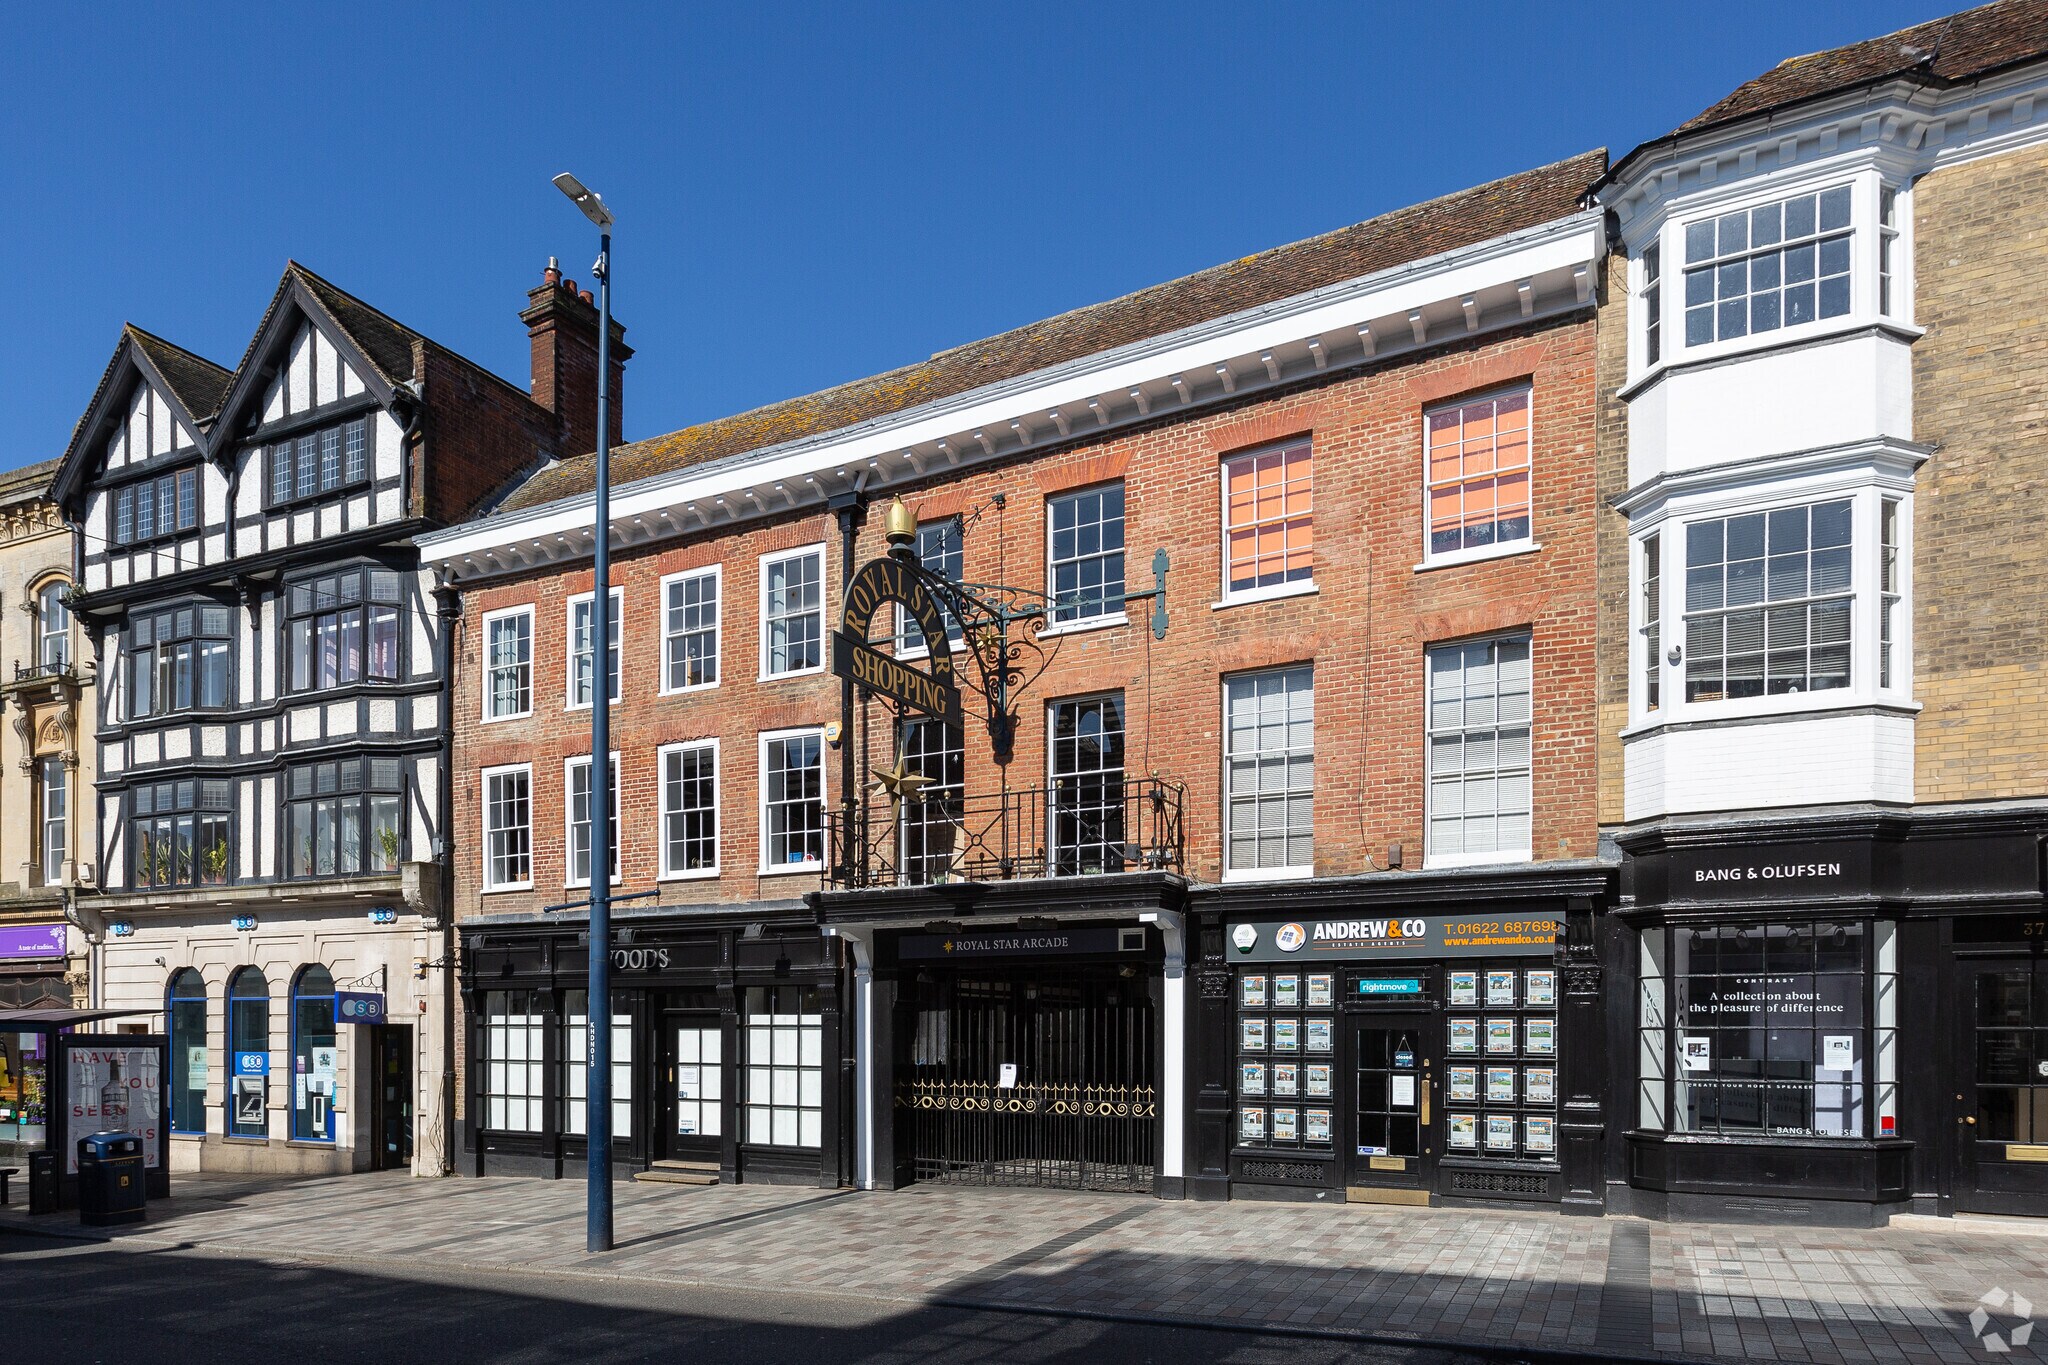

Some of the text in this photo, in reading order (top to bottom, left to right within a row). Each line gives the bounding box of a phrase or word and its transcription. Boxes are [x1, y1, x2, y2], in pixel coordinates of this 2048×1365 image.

[845, 563, 951, 675] ROYAL STAR
[852, 646, 947, 714] SHOPPING
[1695, 862, 1841, 882] BANG & OLUFSEN
[1312, 919, 1426, 940] ANDREW&CO
[1443, 920, 1560, 935] T.01622 687698
[2023, 922, 2045, 936] 37
[956, 936, 1069, 951] ROYAL STAR ARCADE
[1443, 932, 1556, 946] www.andrewandco.co.u
[609, 948, 671, 970] OODS
[1362, 982, 1408, 993] rightmove
[1709, 991, 1821, 1001] A collection about
[1689, 1003, 1844, 1014] the pleasure of difference
[72, 1051, 128, 1064] HAVE
[242, 1055, 263, 1068] TSB
[73, 1104, 127, 1117] SEEN
[1776, 1126, 1803, 1135] BANG
[1818, 1128, 1863, 1137] OLUFSEN
